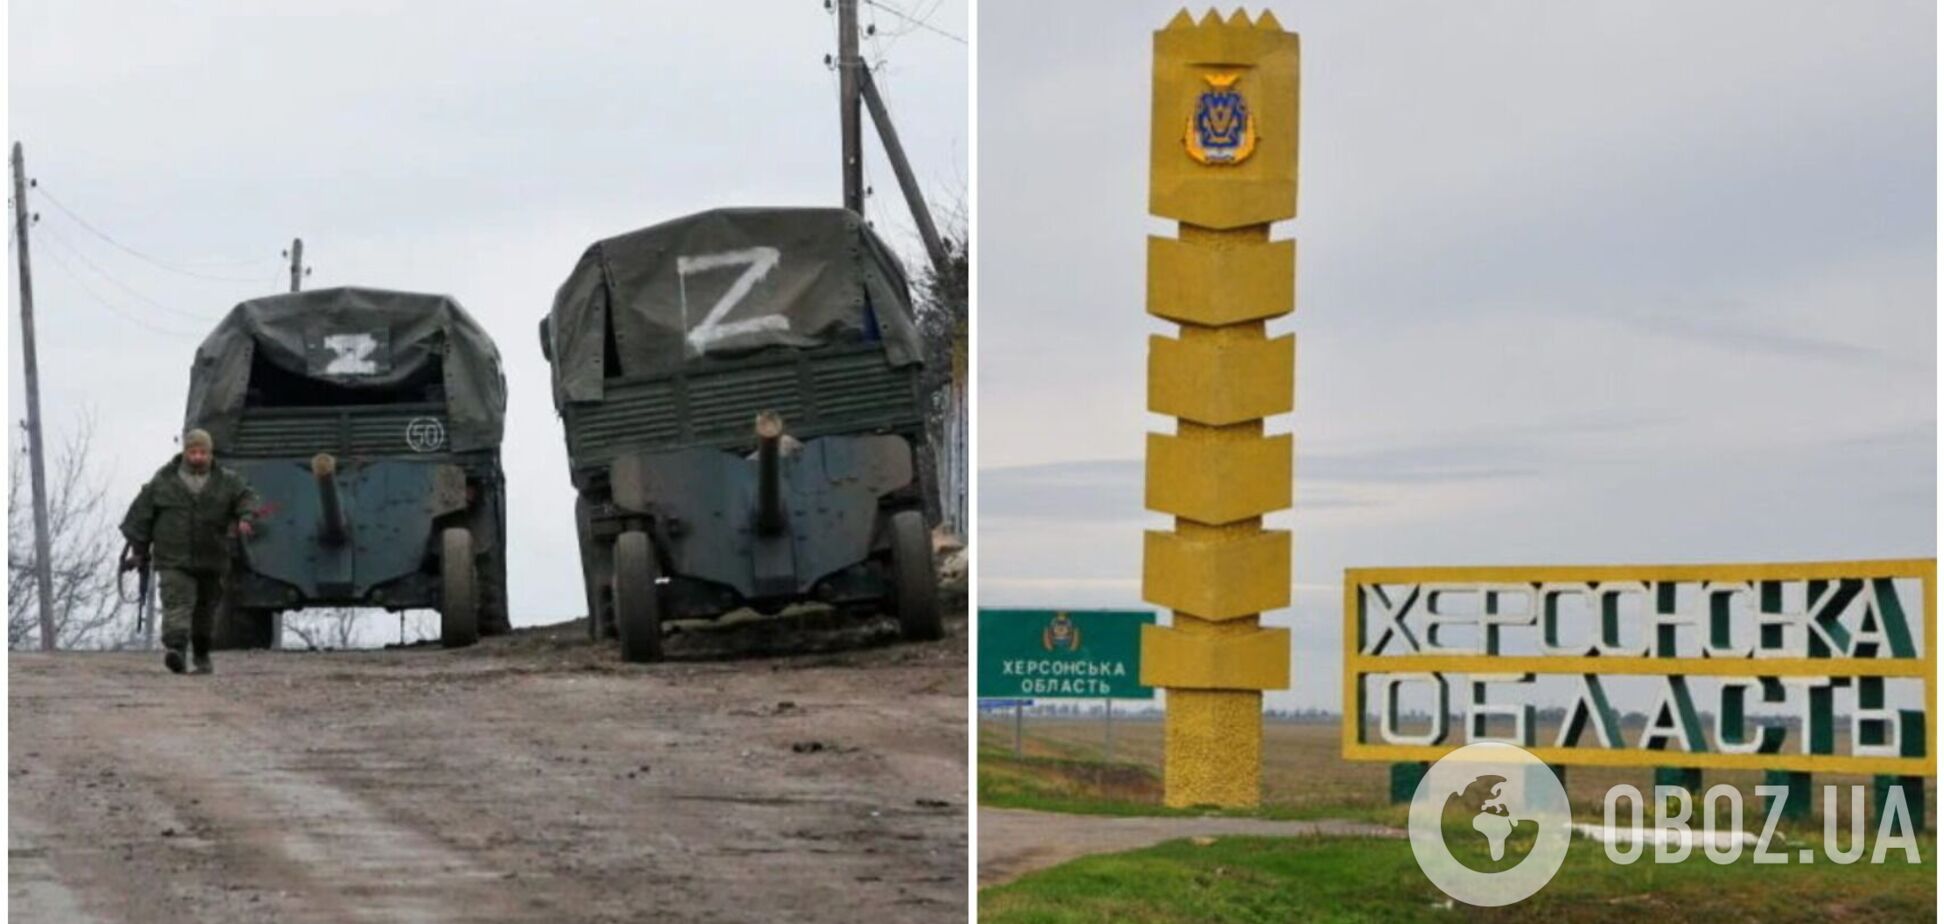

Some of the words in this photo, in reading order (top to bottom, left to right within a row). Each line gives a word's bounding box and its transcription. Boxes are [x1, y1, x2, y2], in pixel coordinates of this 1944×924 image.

[677, 247, 790, 354] Z
[324, 333, 378, 374] Z
[1360, 579, 1896, 657] ХЕРСОНСЬКА
[1003, 660, 1126, 676] ХЕРСОНСЬКА
[1022, 678, 1111, 694] ОБЛАСТЬ
[1379, 673, 1902, 757] ОБЛАСТЬ
